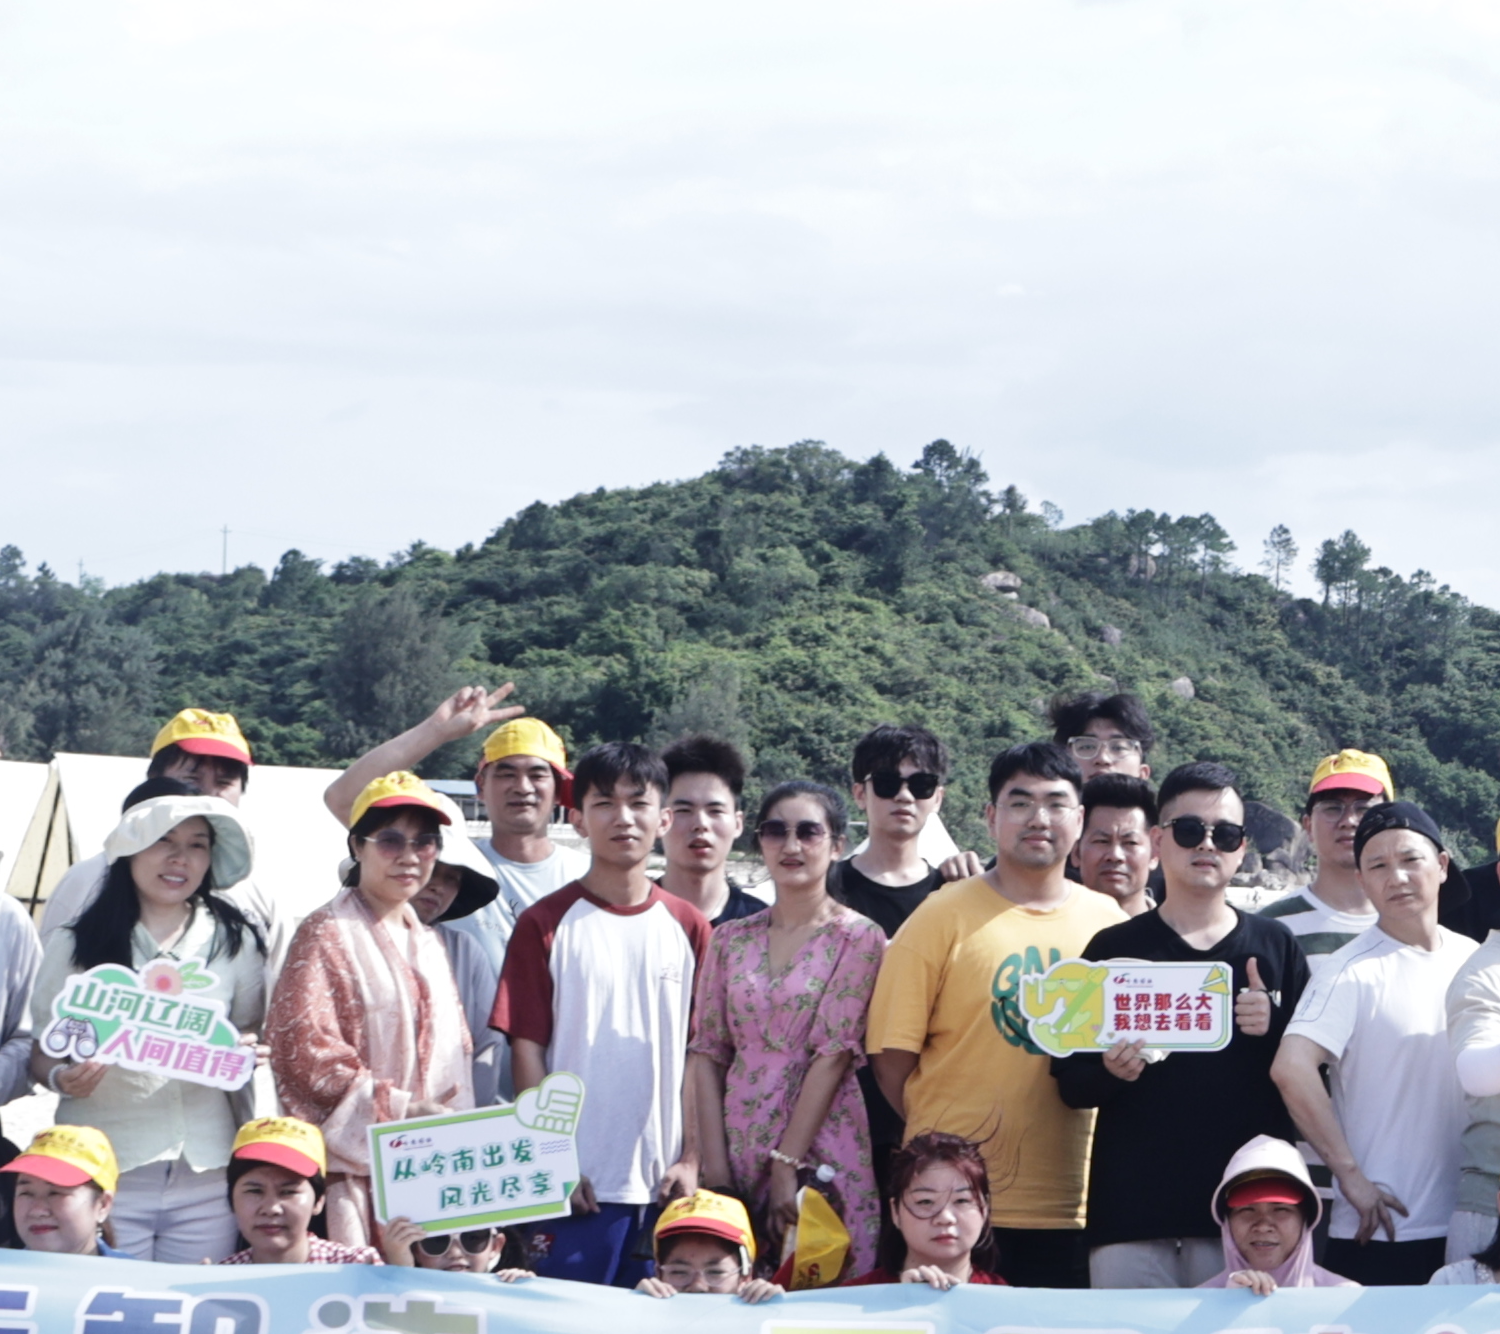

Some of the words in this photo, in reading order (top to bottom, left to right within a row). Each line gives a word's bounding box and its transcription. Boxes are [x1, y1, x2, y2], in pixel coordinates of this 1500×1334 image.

[69, 982, 215, 1036] 山河辽阔
[1114, 993, 1212, 1011] 世界那么大
[1114, 1013, 1211, 1031] 我想去看看
[102, 1029, 246, 1081] 人间值得
[393, 1138, 534, 1181] 从岭南出发
[440, 1171, 552, 1209] 风光尽享
